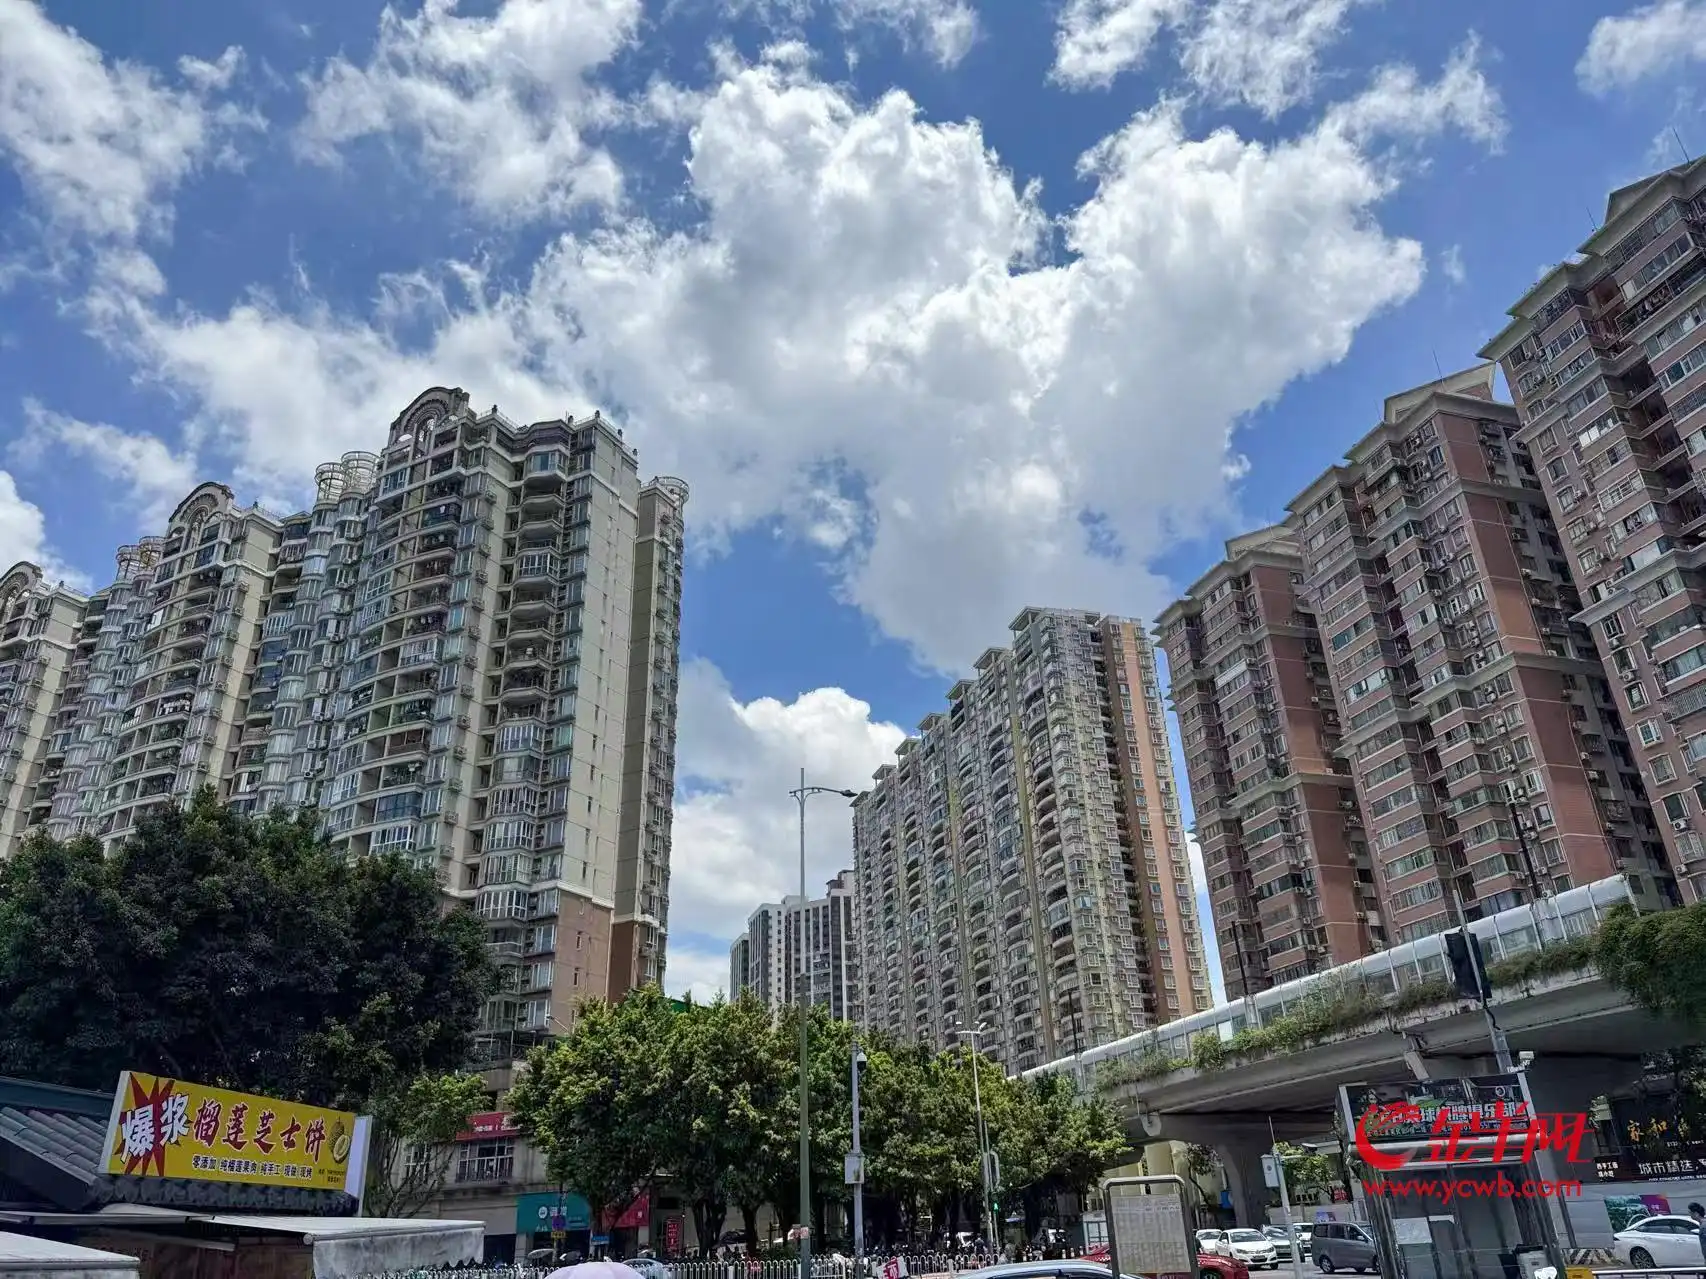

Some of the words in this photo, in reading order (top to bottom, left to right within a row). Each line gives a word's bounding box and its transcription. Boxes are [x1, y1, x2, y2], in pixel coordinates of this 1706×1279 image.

[121, 1093, 190, 1164] 爆浆
[193, 1098, 327, 1163] 榴莲芝士饼
[192, 1154, 217, 1170] 零添加
